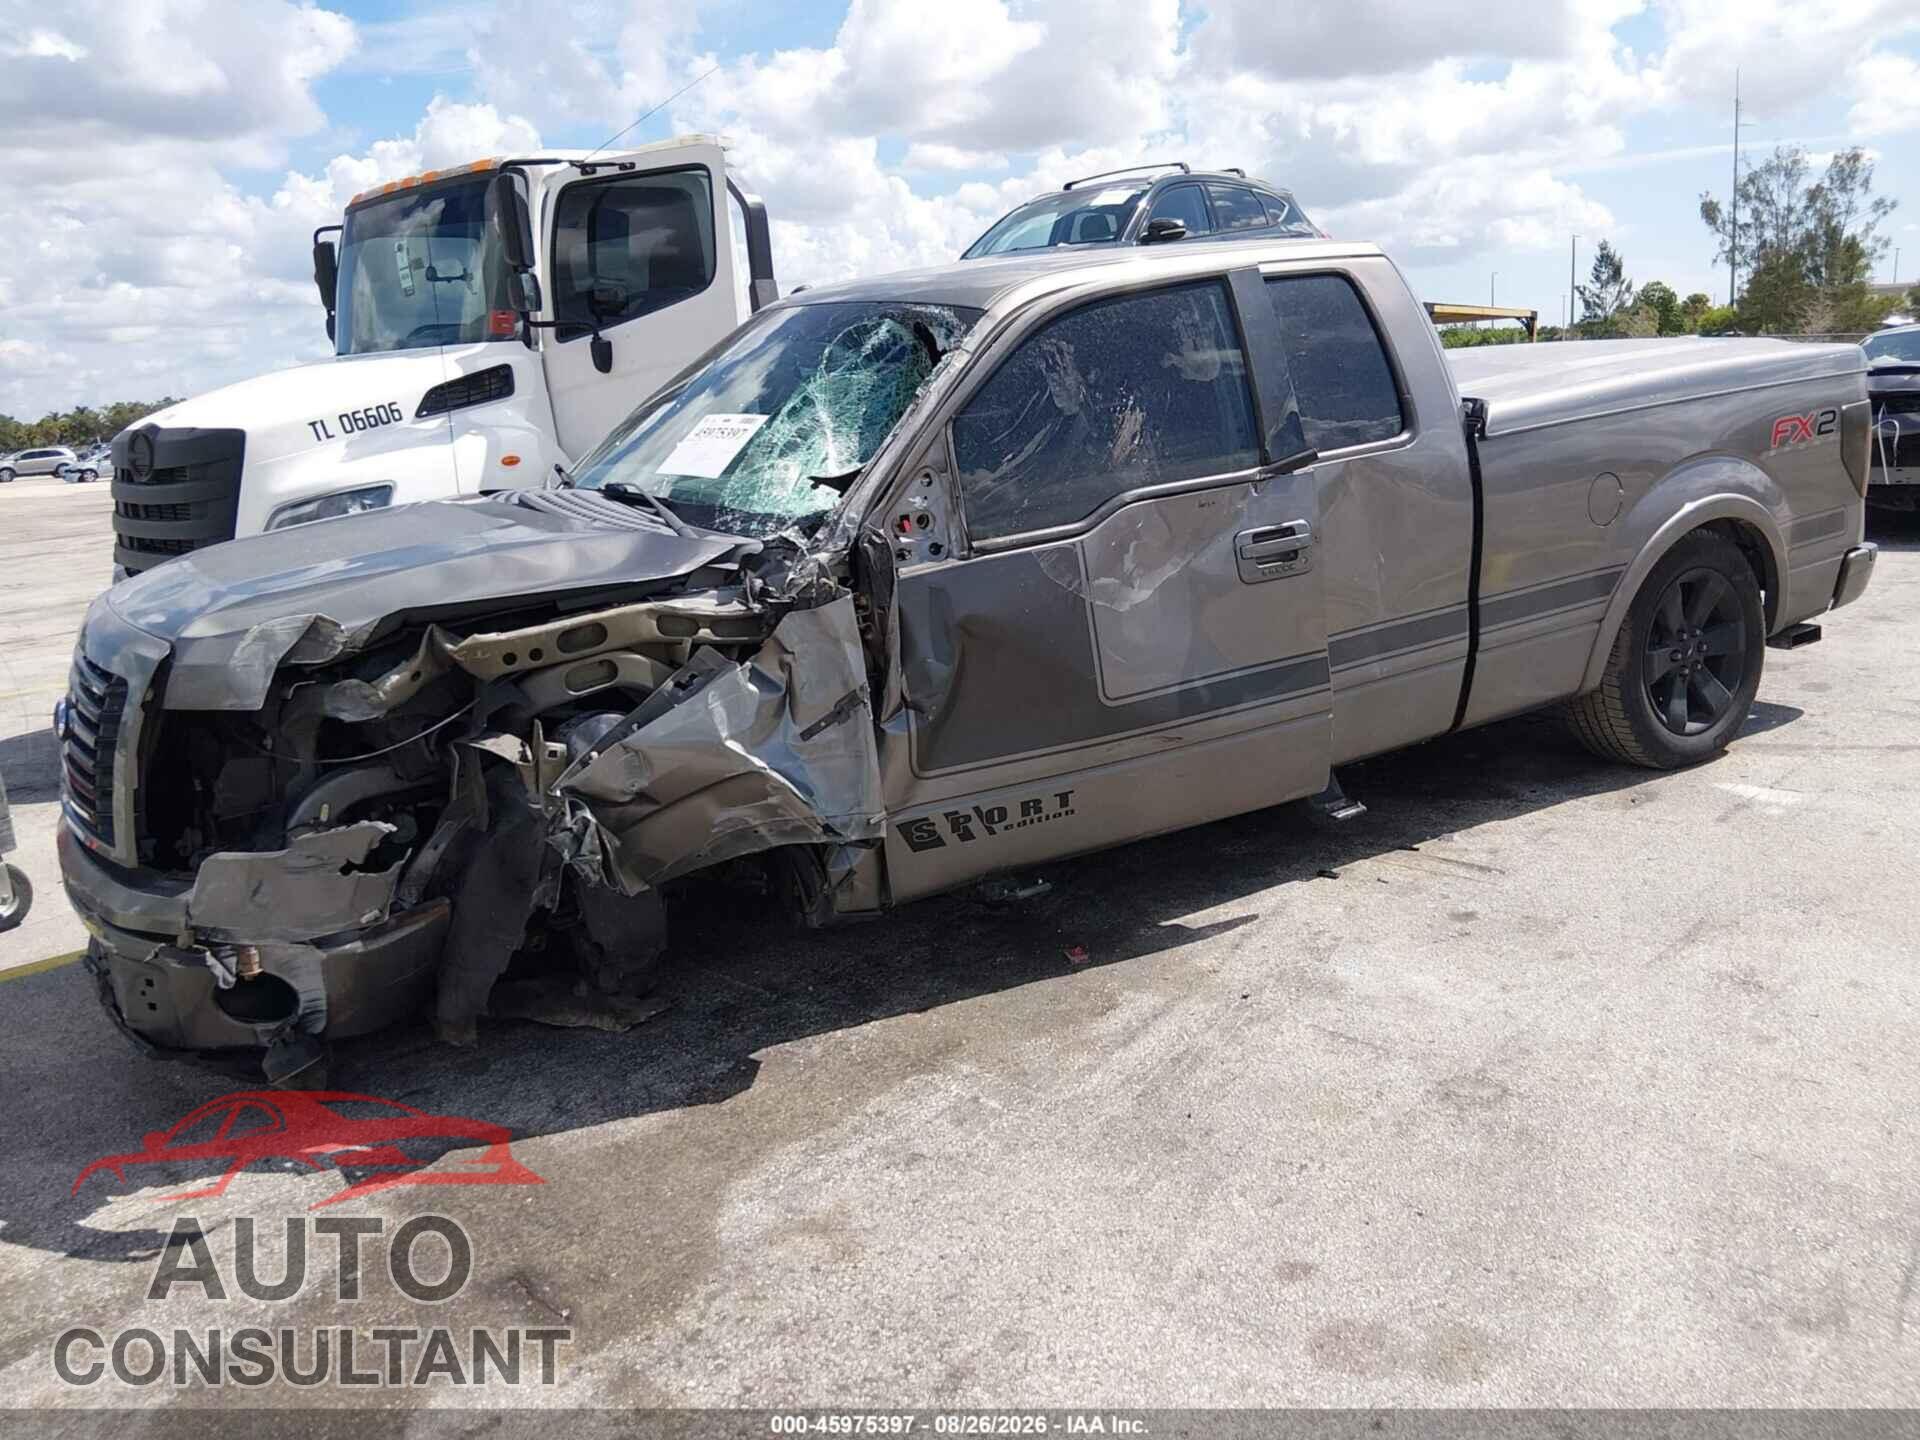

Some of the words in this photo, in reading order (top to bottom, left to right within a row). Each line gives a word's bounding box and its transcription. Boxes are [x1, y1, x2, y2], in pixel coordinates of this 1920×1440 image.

[307, 419, 335, 441] TL
[338, 401, 403, 434] 06606
[1771, 409, 1837, 448] FX2
[896, 790, 1075, 852] SPORT
[1003, 809, 1075, 831] edition
